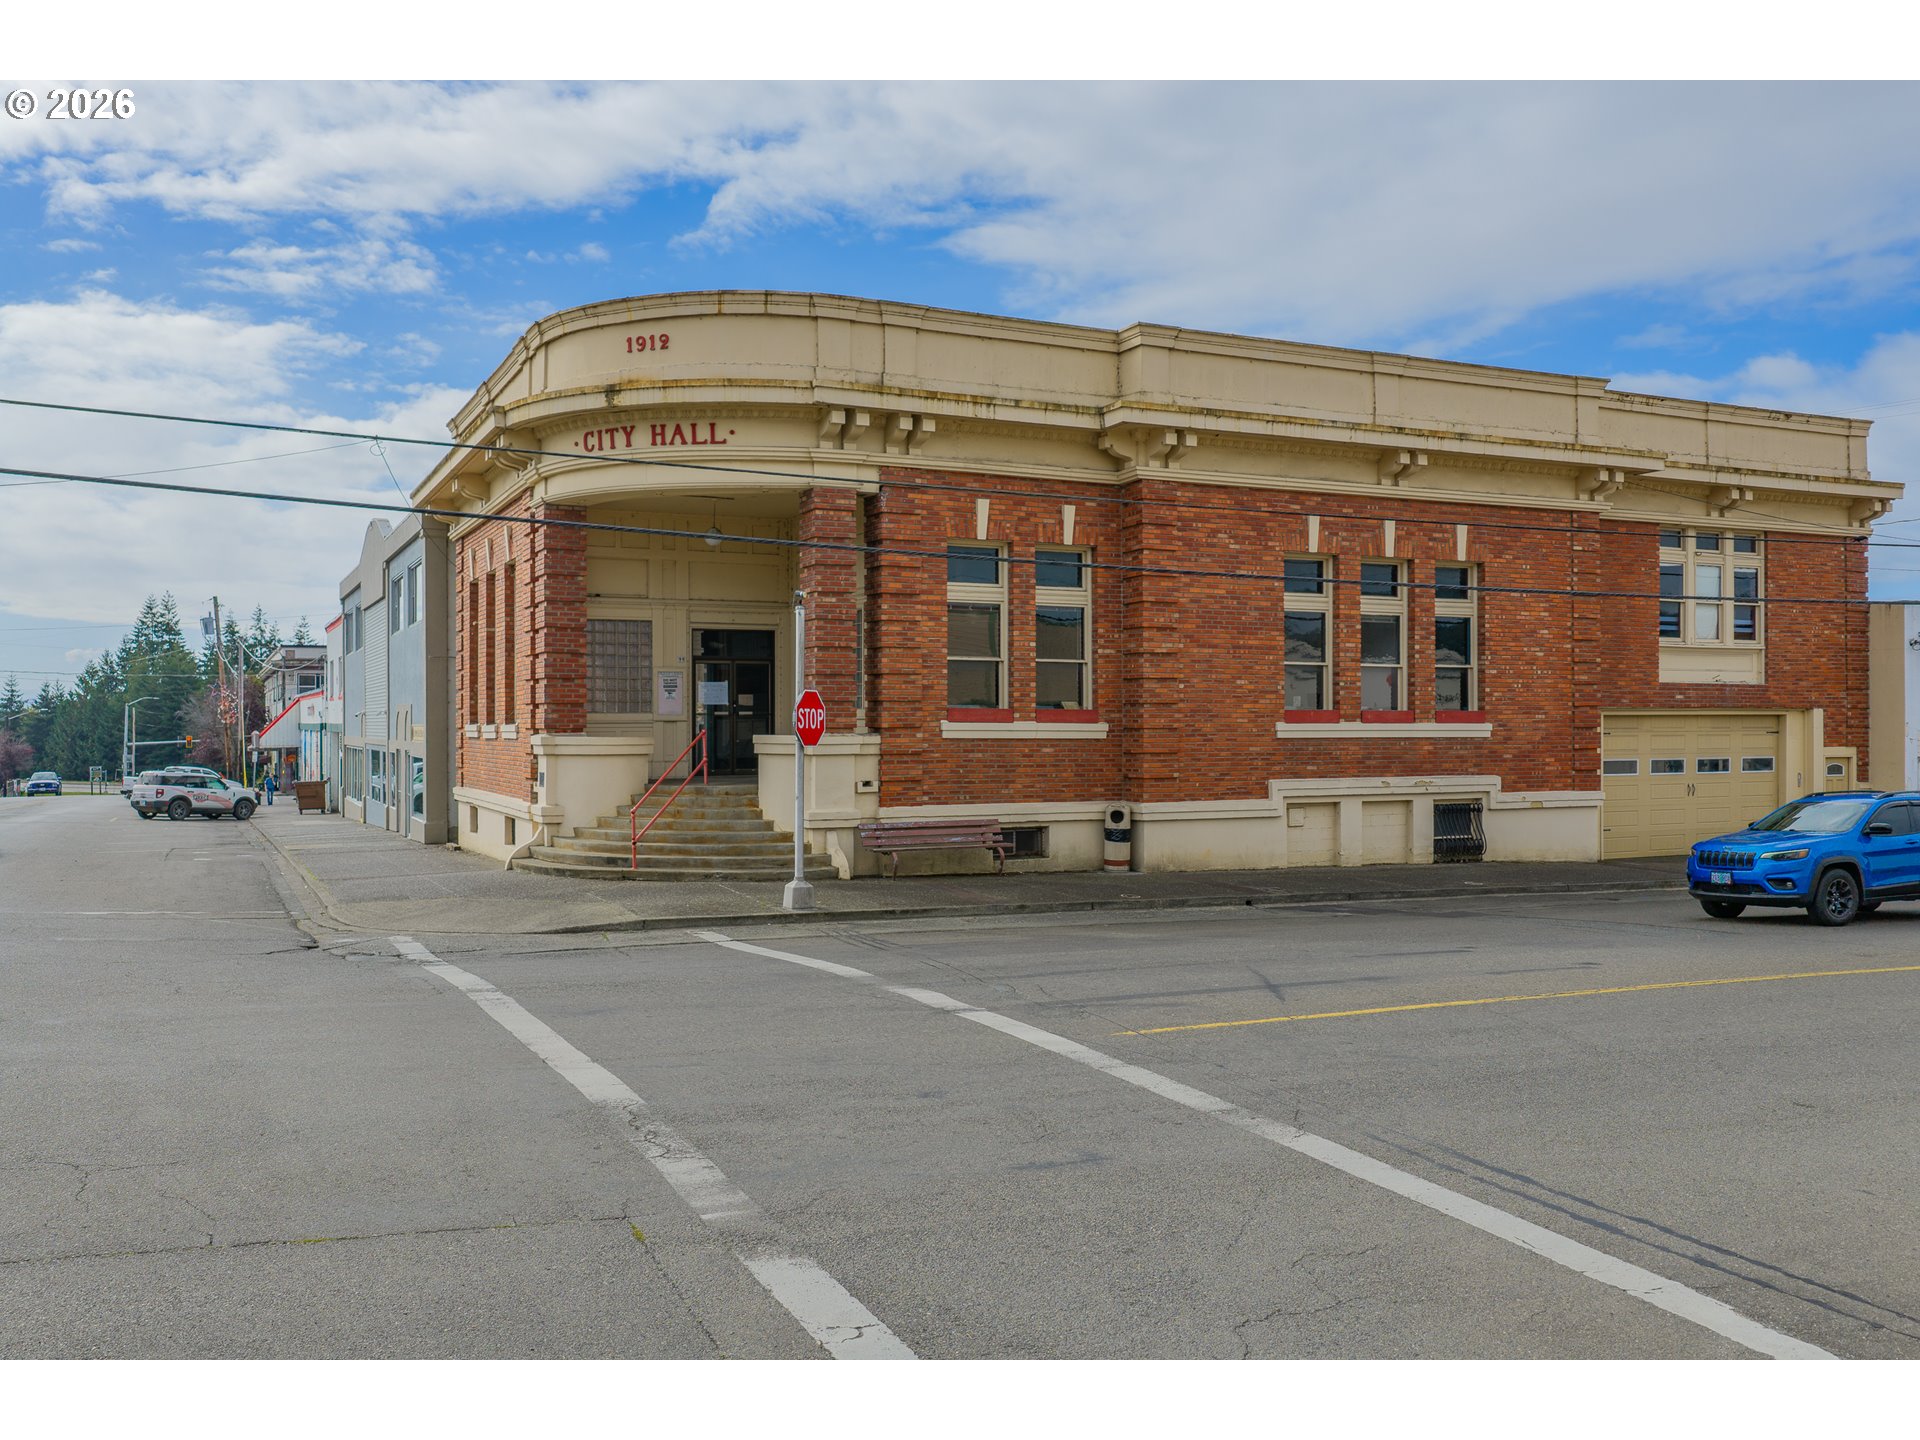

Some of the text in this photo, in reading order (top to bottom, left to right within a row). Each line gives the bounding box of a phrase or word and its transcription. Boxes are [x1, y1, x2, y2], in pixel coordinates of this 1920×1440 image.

[626, 333, 670, 353] 1912
[583, 422, 727, 453] CITY HALL
[797, 707, 824, 729] STOP
